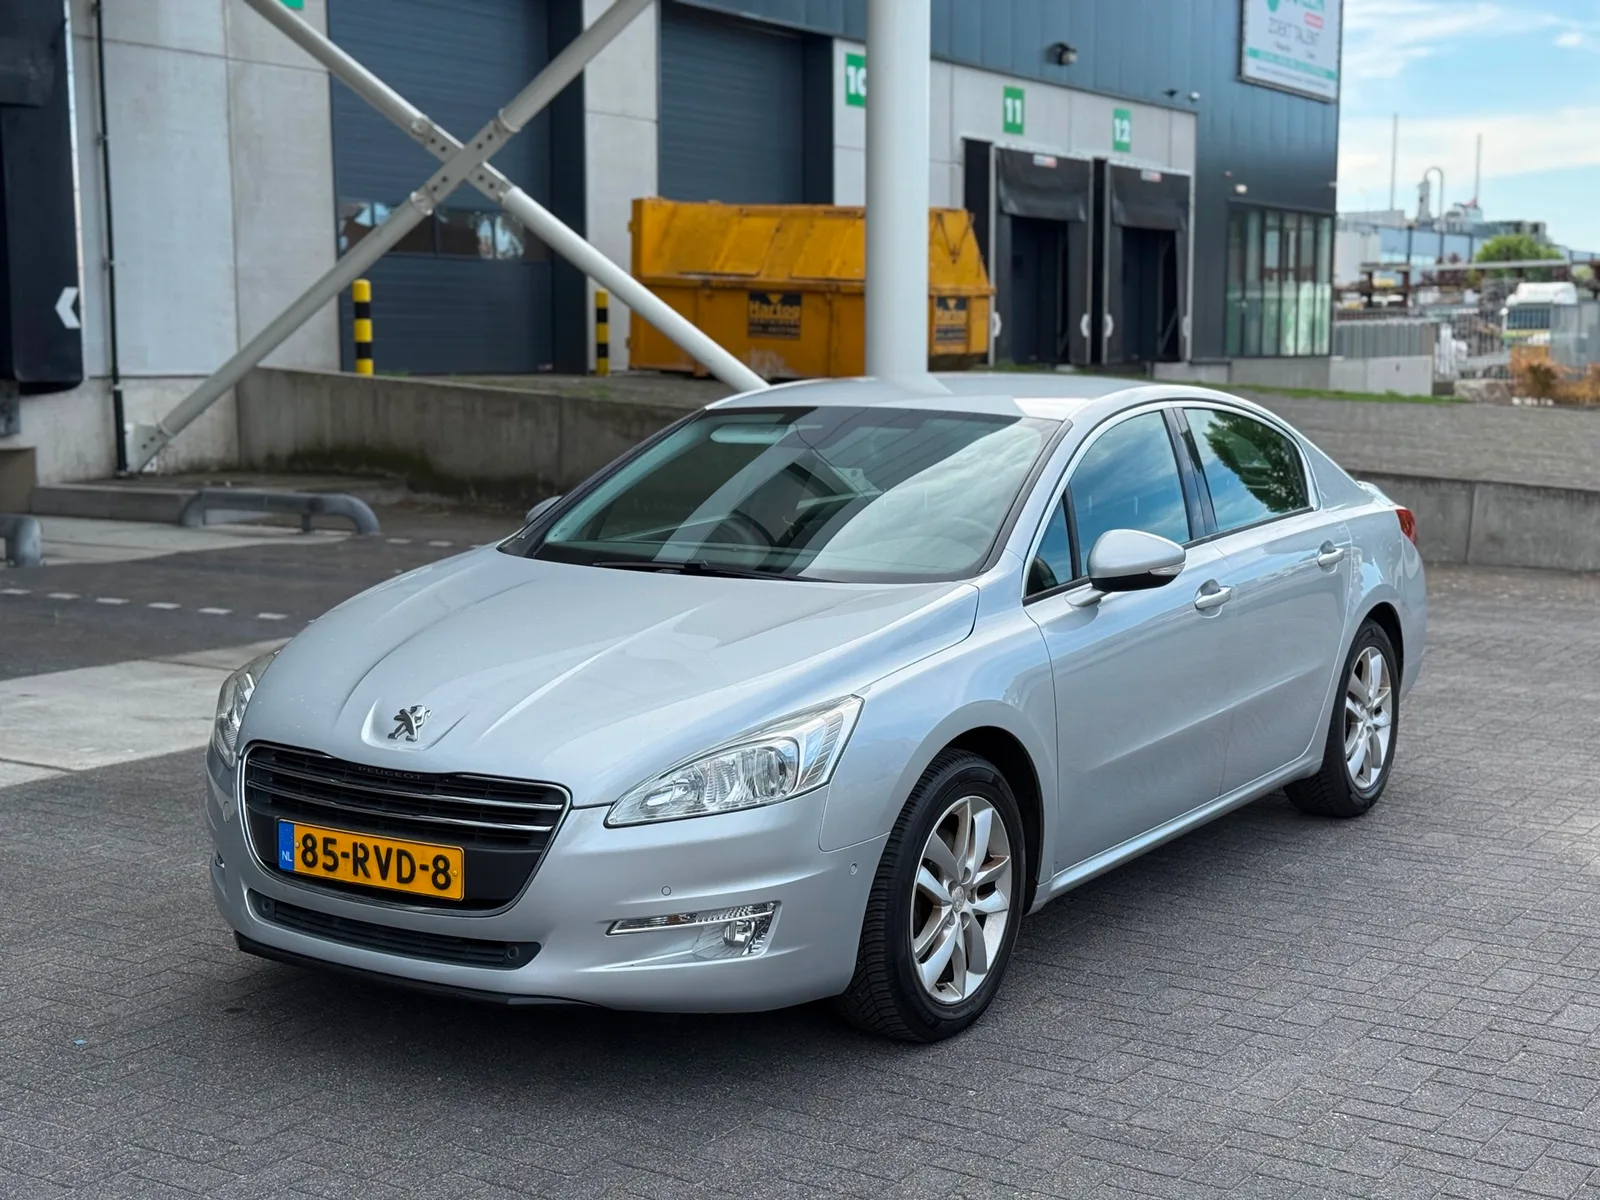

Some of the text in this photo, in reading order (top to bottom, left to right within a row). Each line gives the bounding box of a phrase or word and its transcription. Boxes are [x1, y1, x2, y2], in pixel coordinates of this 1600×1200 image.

[1005, 97, 1021, 124] 11
[1114, 117, 1131, 143] 12
[358, 765, 422, 780] PEUGEOT
[281, 849, 293, 863] NL
[301, 833, 452, 890] 85-RVD-8
